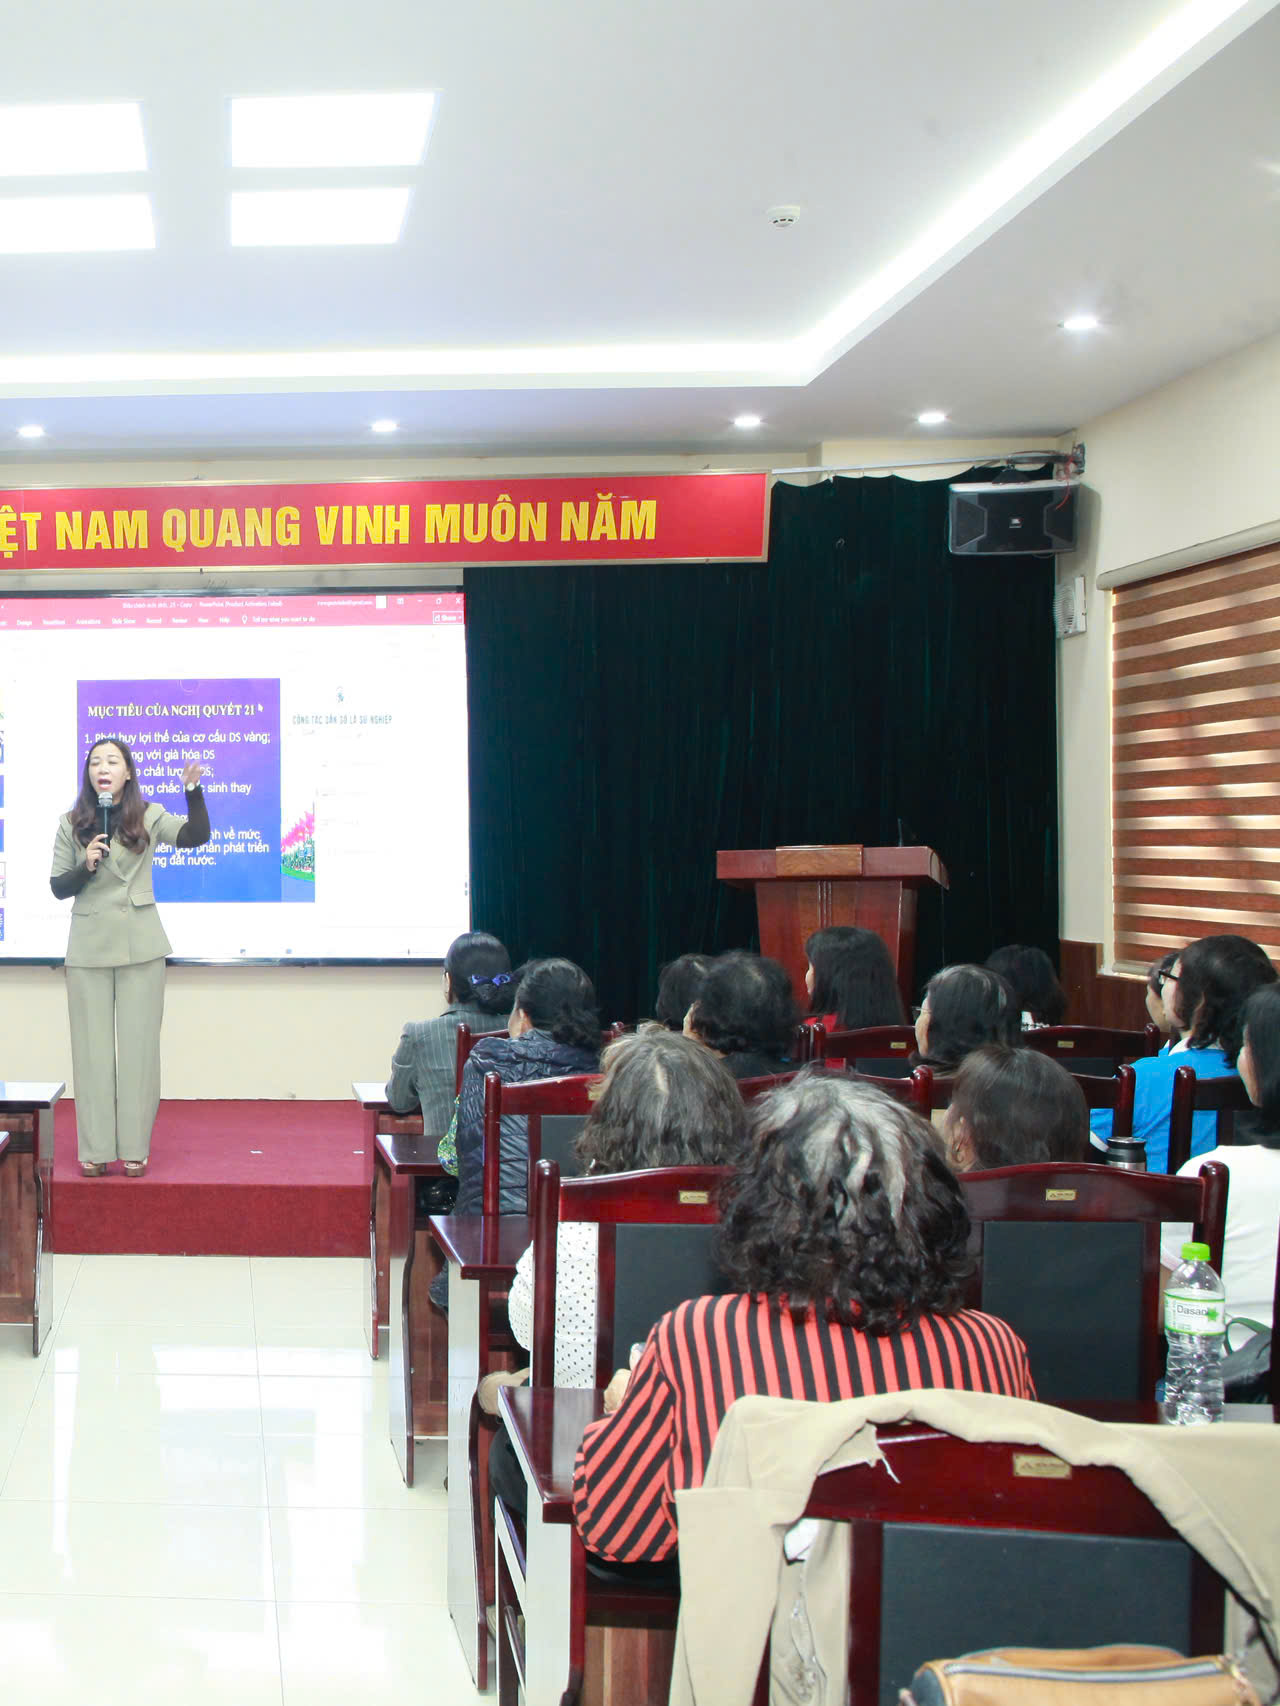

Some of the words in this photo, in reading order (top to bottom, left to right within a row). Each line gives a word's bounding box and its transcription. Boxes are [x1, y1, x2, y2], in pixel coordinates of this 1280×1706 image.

[55, 510, 149, 551] NAM
[162, 506, 301, 553] QUANG
[316, 504, 411, 546] VINH
[425, 494, 547, 544] MUÔN
[561, 491, 657, 541] NĂM
[87, 705, 114, 719] MỤC
[116, 702, 143, 717] TIÊU
[145, 702, 169, 717] CỦA
[171, 704, 200, 718] NGHỊ
[202, 701, 242, 717] QUYẾT
[244, 704, 255, 716] 21
[84, 733, 93, 744] 1.
[118, 732, 137, 746] huy
[139, 731, 152, 745] lợi
[154, 729, 169, 743] thế
[172, 731, 190, 743] của
[192, 732, 206, 742] cơ
[209, 728, 226, 742] cấu
[229, 732, 241, 742] DS
[243, 731, 271, 745] vàng;
[146, 749, 162, 760] với
[164, 749, 180, 763] già
[181, 749, 200, 760] hóa
[202, 750, 215, 760] DS
[143, 763, 165, 777] chất
[156, 779, 181, 793] chắc
[207, 781, 228, 793] sinh
[230, 782, 252, 796] thay
[223, 827, 236, 840] về
[237, 828, 261, 840] mức
[223, 841, 245, 856] phát
[247, 839, 270, 853] triển
[187, 854, 217, 866] nước.
[1176, 1304, 1209, 1316] Dasan
